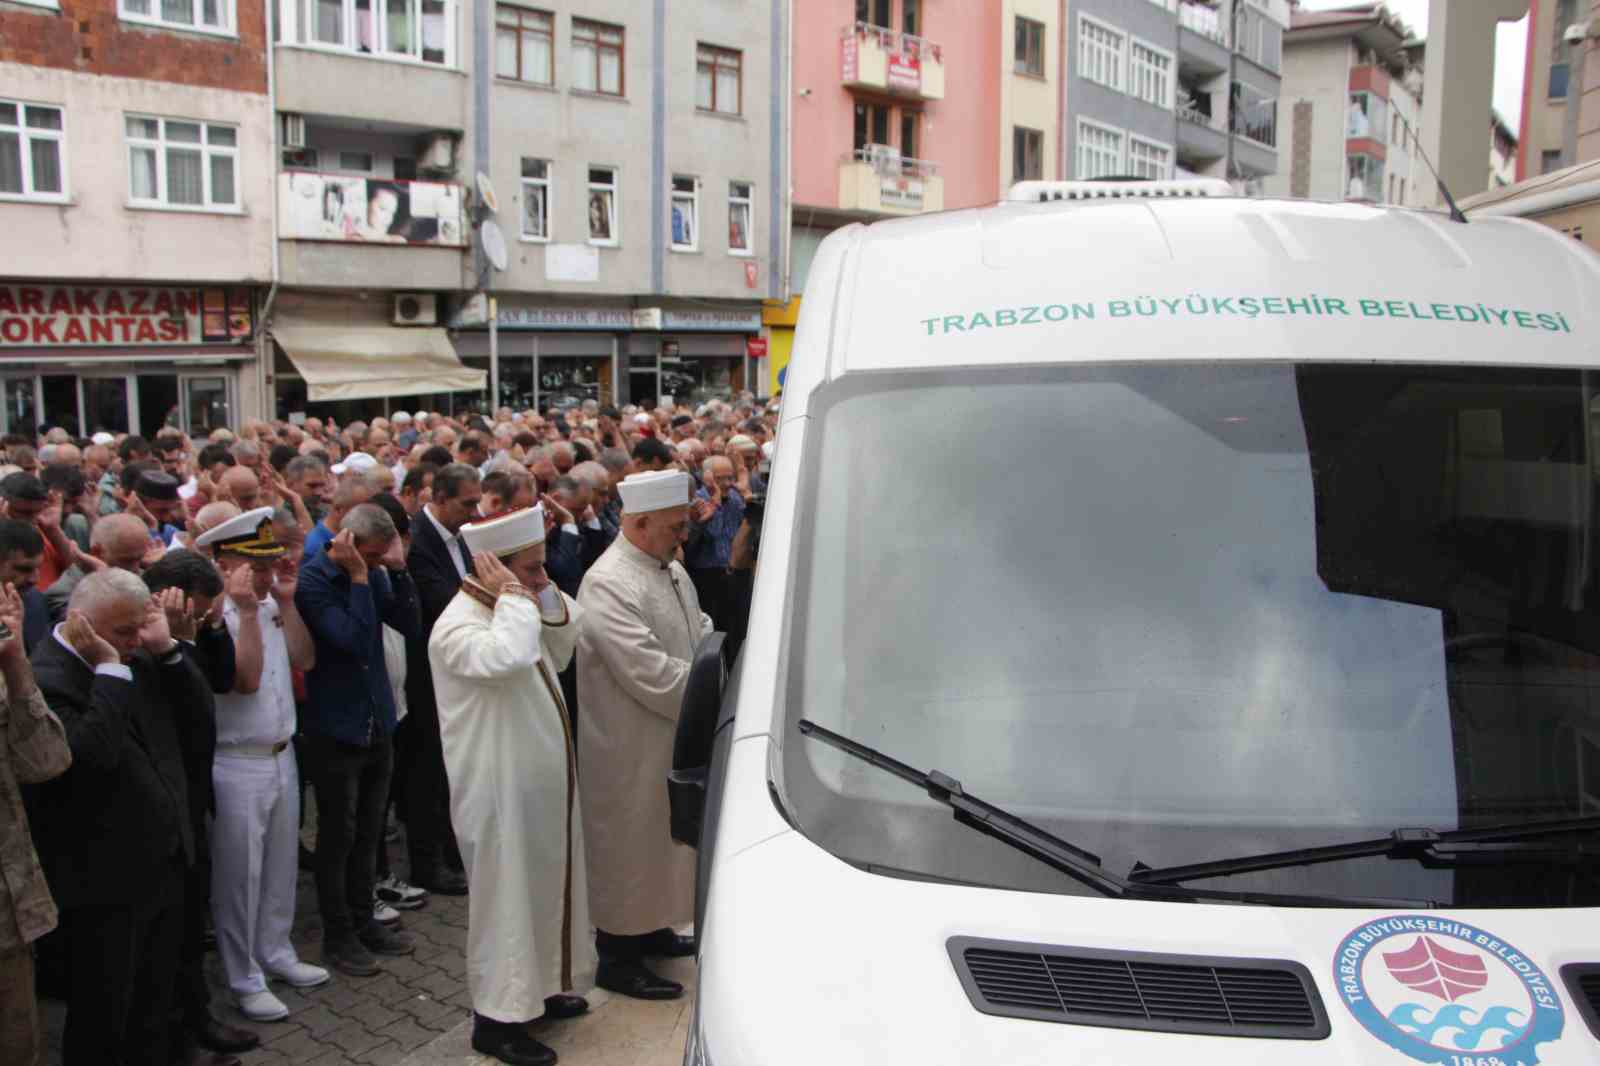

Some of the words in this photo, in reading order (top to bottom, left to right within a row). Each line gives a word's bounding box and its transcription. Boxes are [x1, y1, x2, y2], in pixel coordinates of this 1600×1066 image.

[0, 317, 188, 343] OKANTASI
[920, 302, 1095, 336] TRABZON
[1108, 294, 1350, 319] BÜYÜKŞEHİR
[1359, 299, 1571, 333] BELEDİYESİ
[1341, 940, 1366, 1003] TRABZON
[1358, 918, 1472, 944] BÜYÜKŞEHİR
[1475, 934, 1560, 1010] BELEDİYESİ
